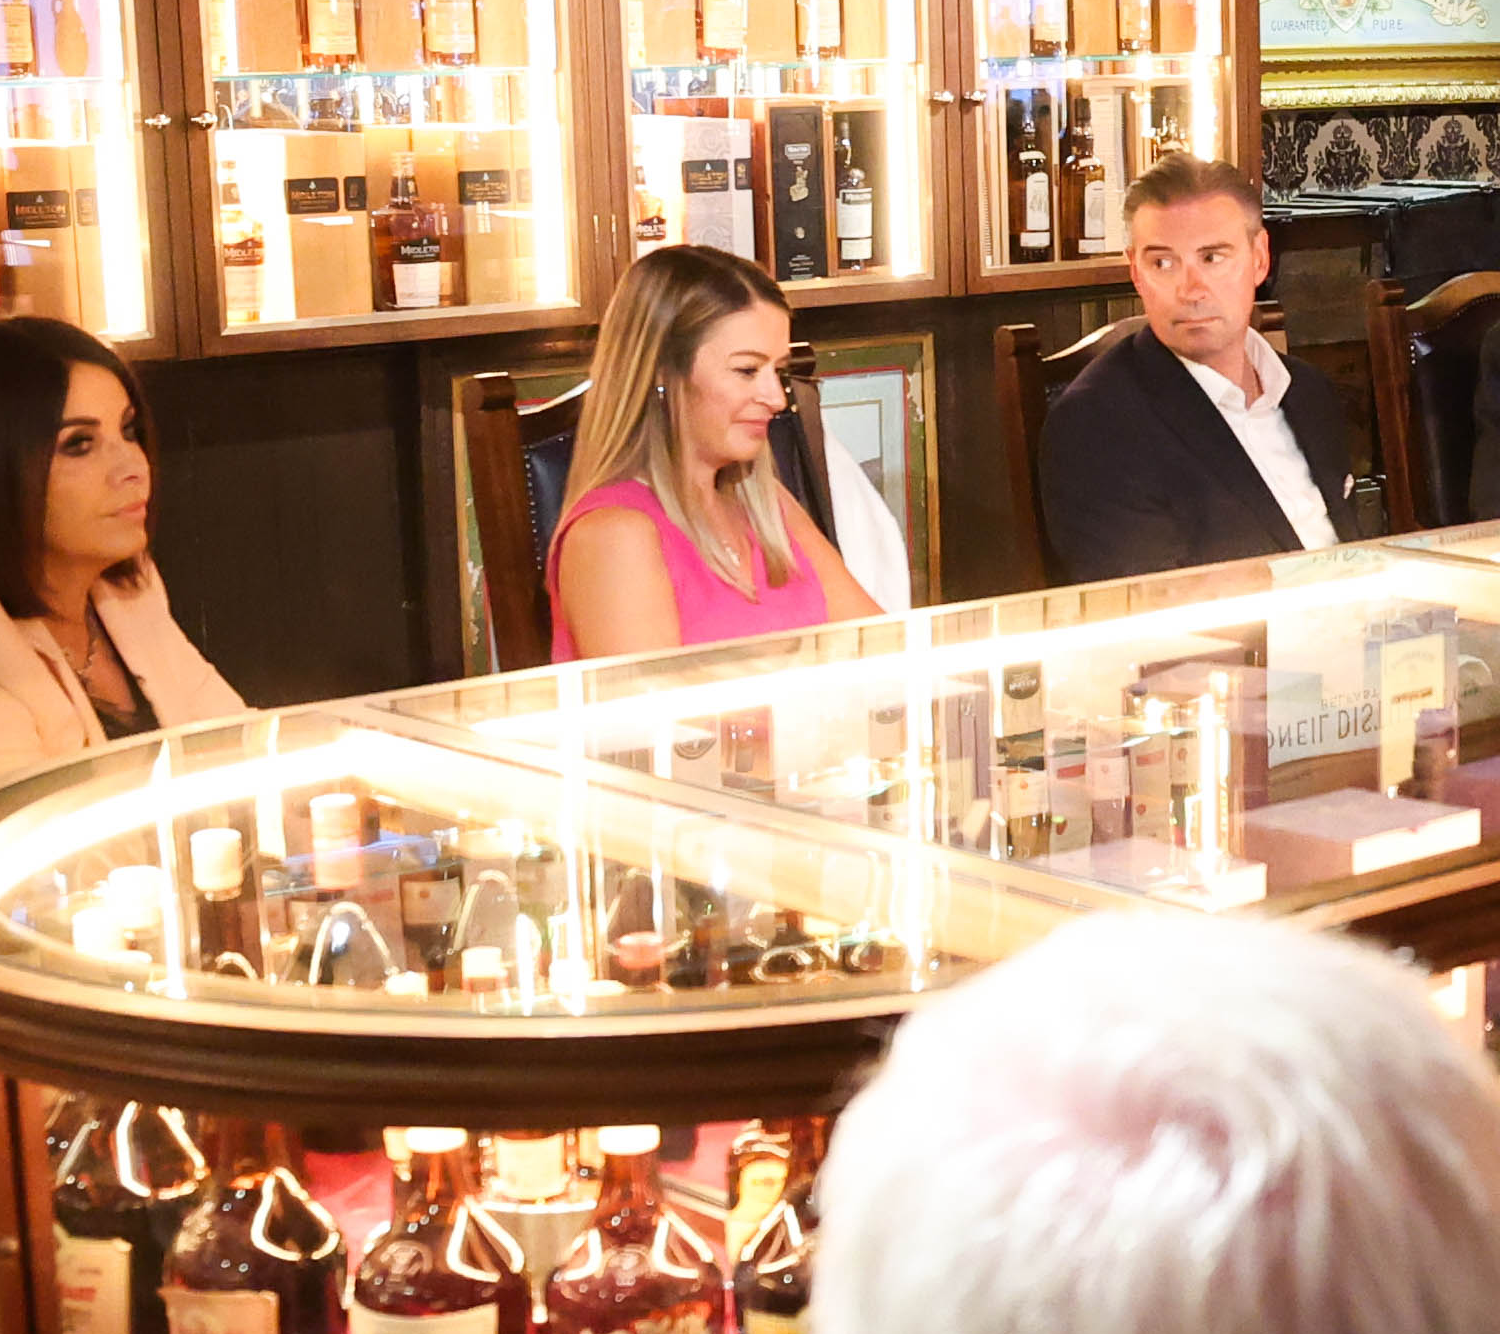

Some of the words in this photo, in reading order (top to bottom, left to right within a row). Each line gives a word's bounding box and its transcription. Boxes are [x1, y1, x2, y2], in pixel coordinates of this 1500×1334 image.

[1270, 19, 1329, 35] GUARANTEED
[1372, 19, 1404, 31] PURE
[15, 202, 67, 216] MIDLETON
